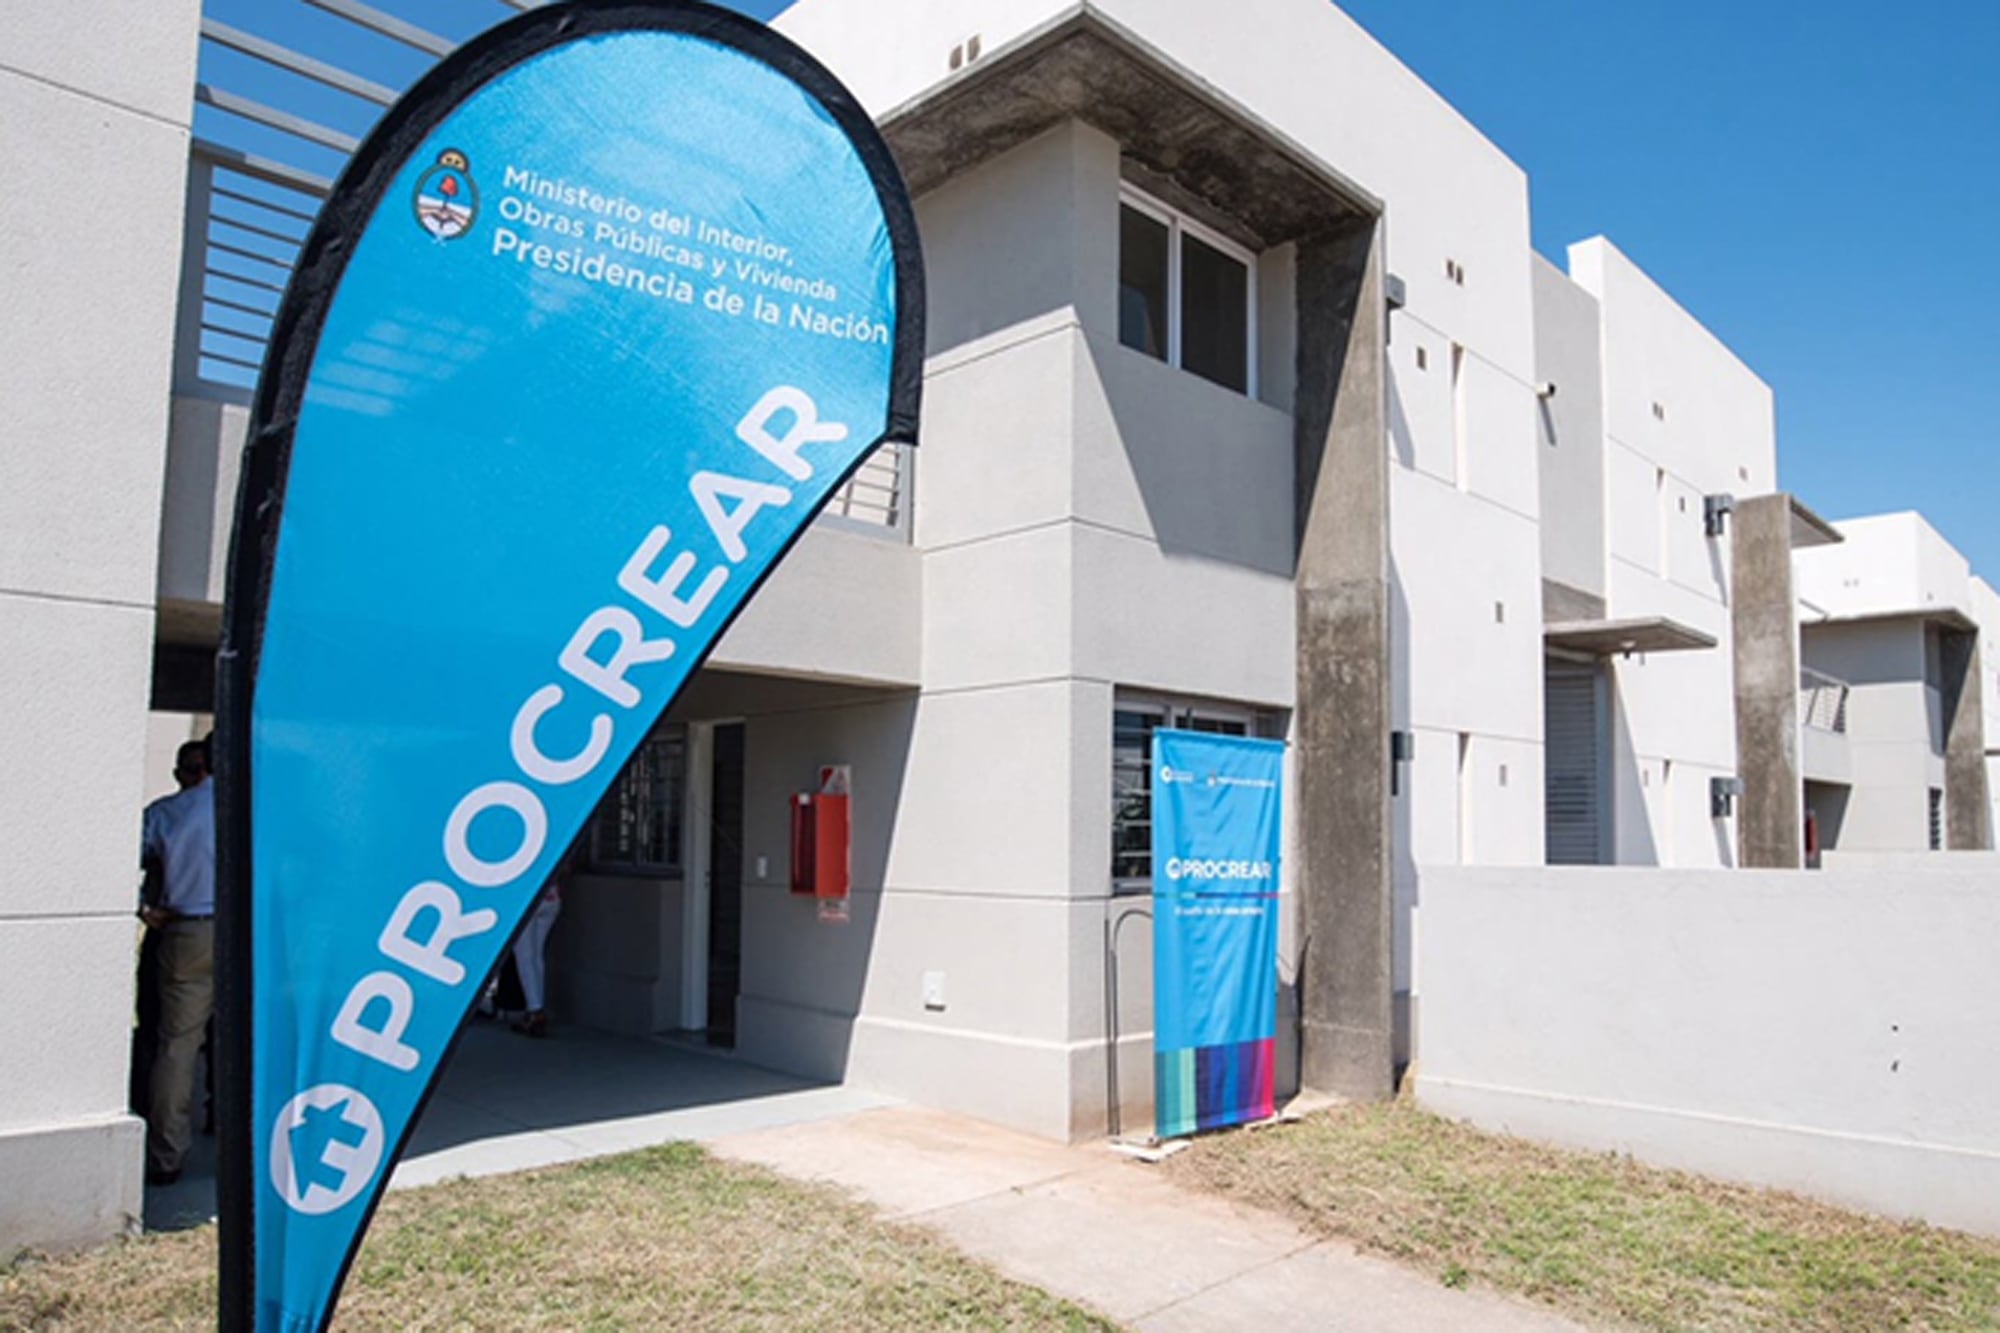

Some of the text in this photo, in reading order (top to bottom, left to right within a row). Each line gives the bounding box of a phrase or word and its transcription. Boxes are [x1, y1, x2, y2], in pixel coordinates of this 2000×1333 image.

[499, 196, 837, 301] Obras Públicas y Vivienda
[503, 165, 794, 267] Ministerio del Interior,
[493, 227, 889, 345] Presidencia de la Nación
[330, 385, 848, 1073] PROCREAR
[1182, 859, 1272, 879] PROCREAR
